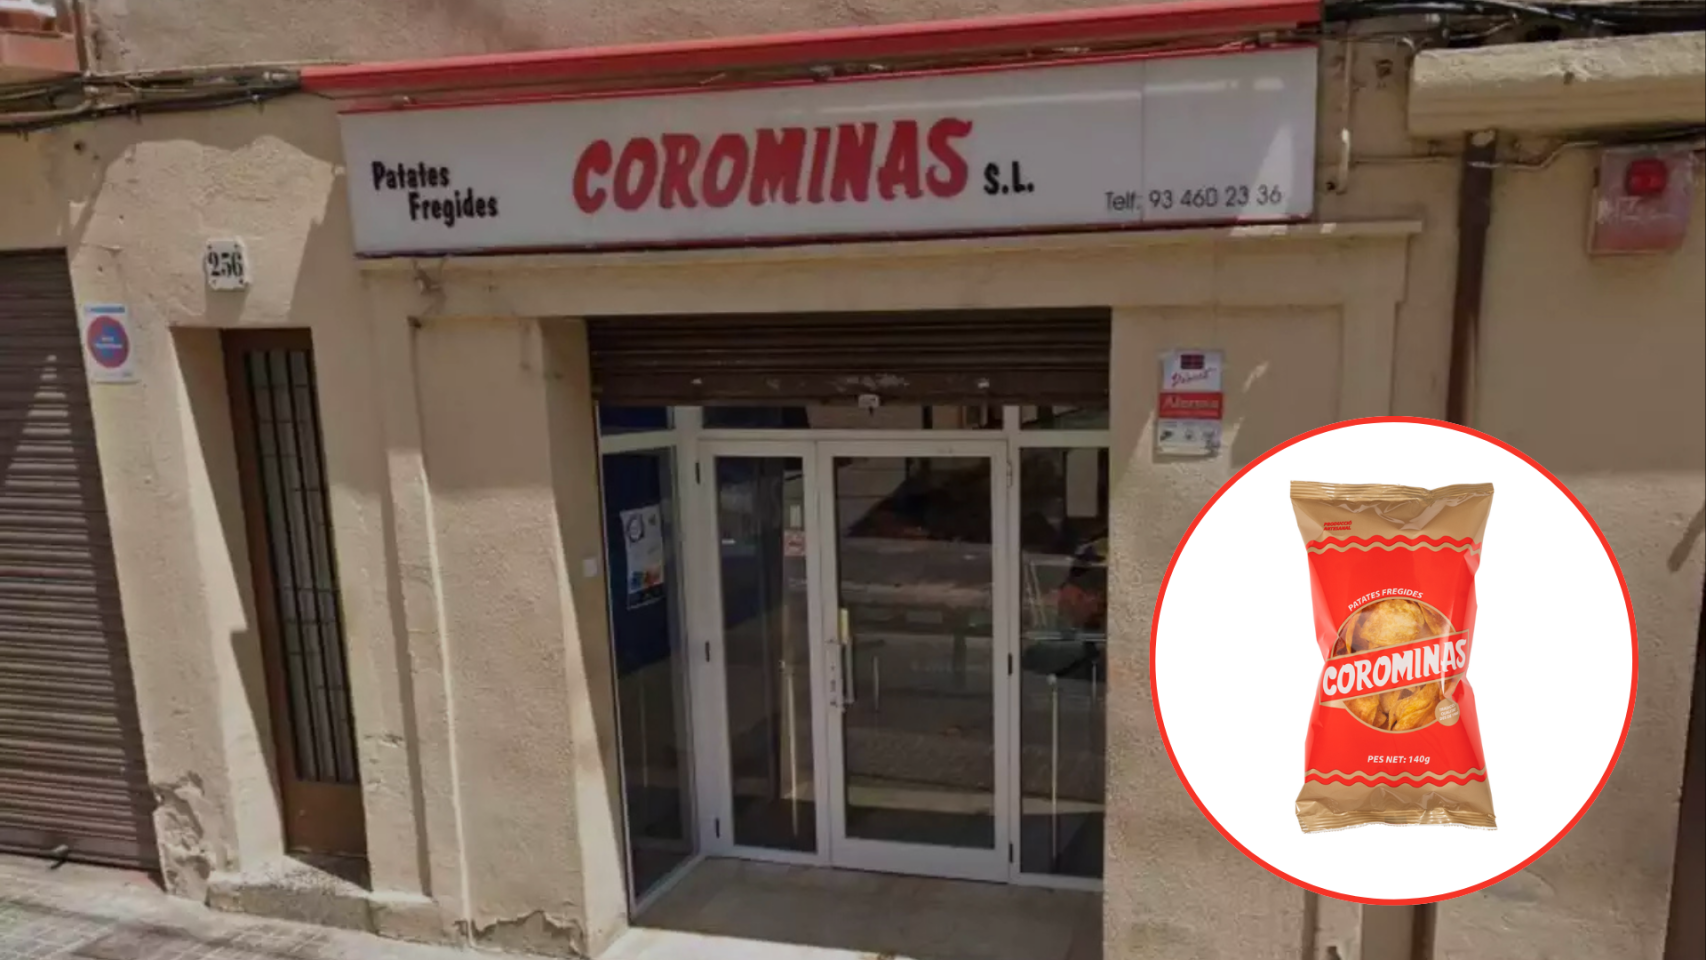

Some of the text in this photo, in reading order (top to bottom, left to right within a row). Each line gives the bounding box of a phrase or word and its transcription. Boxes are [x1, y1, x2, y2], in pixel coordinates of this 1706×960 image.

[371, 160, 450, 191] Patates
[572, 117, 1035, 214] COROMINAS S.L.
[408, 187, 499, 227] Fregides
[1149, 189, 1174, 210] 93
[1180, 187, 1219, 208] 460
[1225, 185, 1249, 207] 23
[1256, 183, 1283, 205] 36
[207, 251, 244, 278] 256
[1347, 587, 1424, 612] PATATES FREGIDES
[1322, 639, 1467, 696] COROMINAS
[1367, 755, 1431, 765] PES NET: 140g
